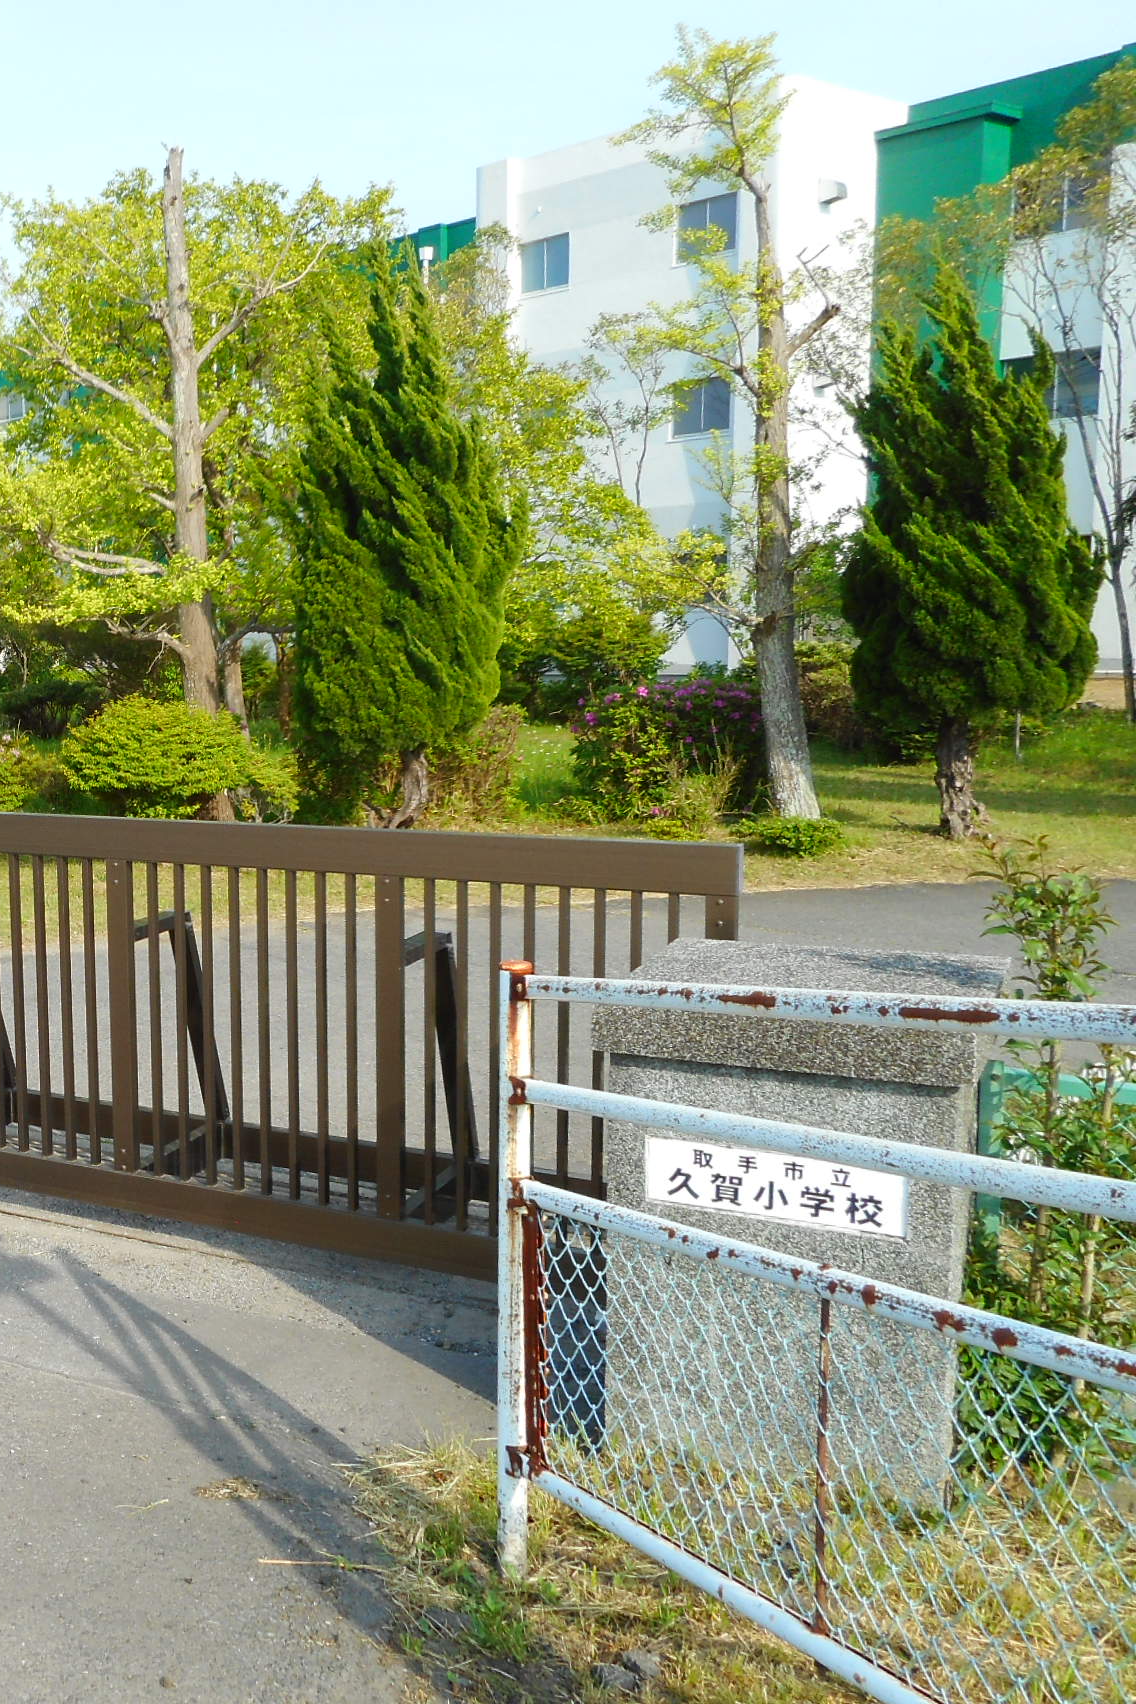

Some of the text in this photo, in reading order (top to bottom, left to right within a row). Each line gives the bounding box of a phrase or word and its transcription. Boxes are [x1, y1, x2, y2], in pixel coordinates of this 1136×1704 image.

[693, 1149, 851, 1188] 取手市立
[668, 1168, 883, 1228] 久賀小学校
